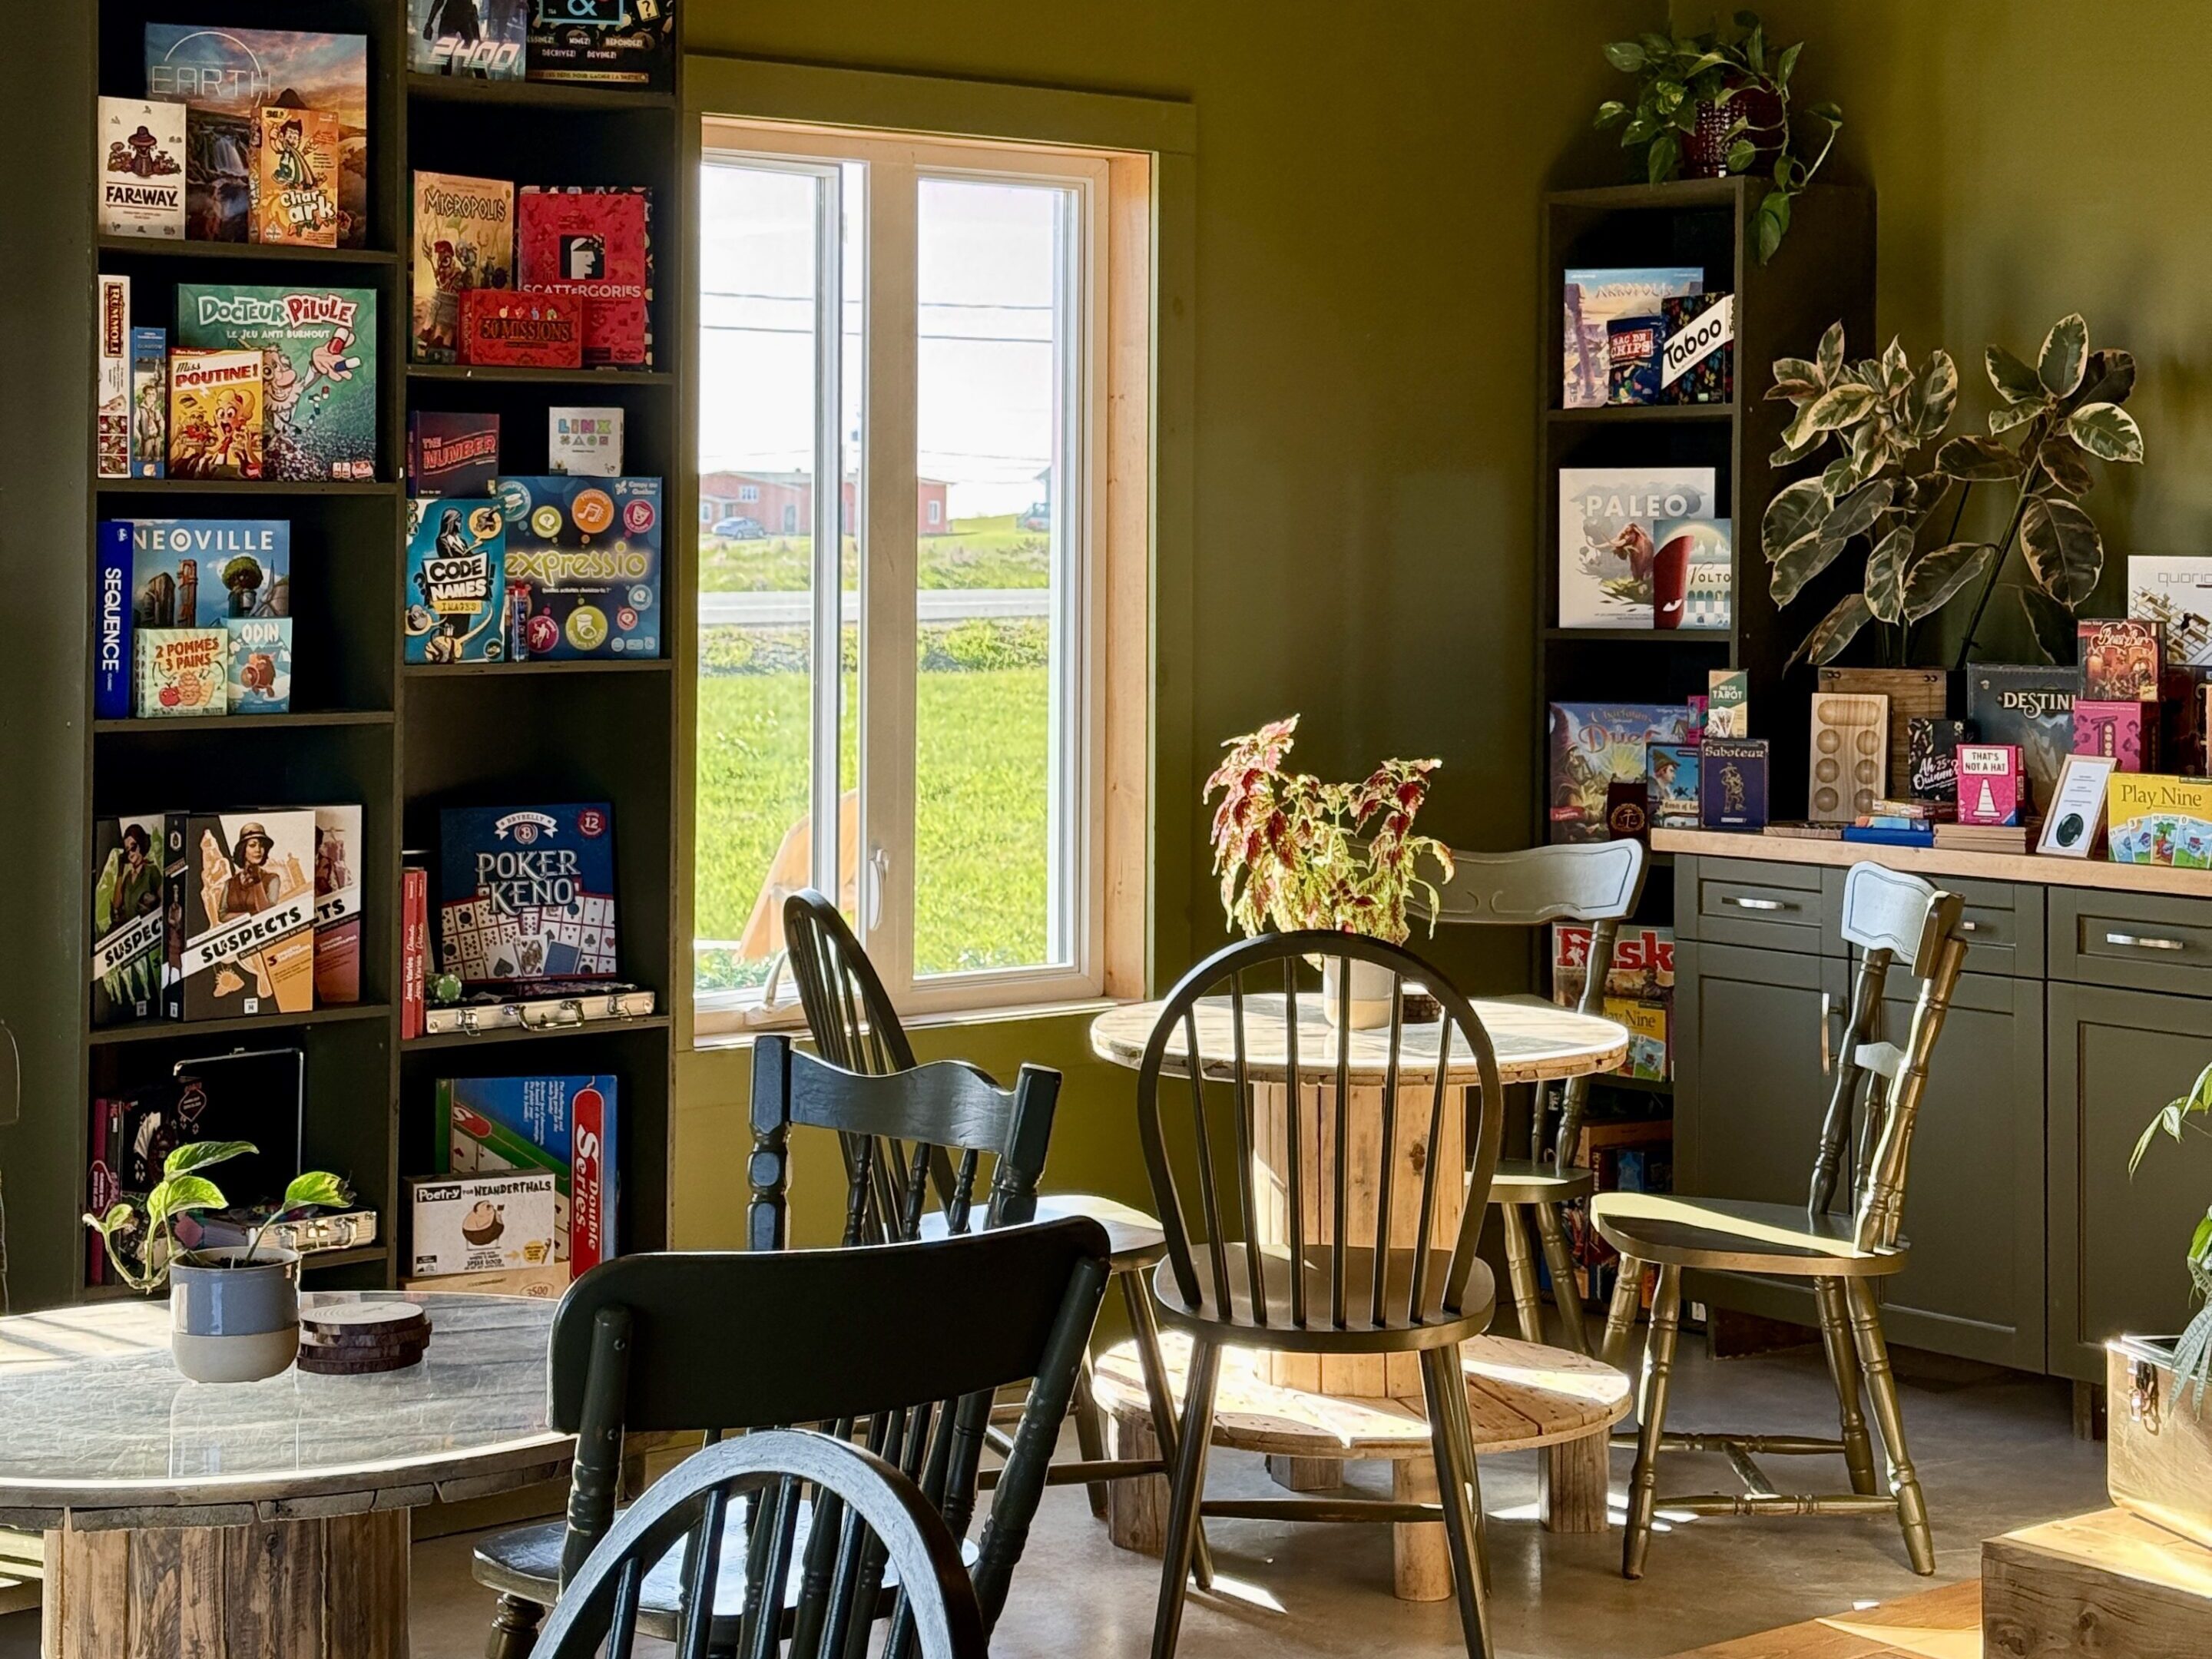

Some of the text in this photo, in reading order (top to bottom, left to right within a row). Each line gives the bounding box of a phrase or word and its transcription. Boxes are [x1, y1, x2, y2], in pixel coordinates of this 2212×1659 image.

[427, 36, 521, 70] 2400
[152, 66, 271, 98] EARTH
[106, 187, 178, 207] FARAWAY
[423, 189, 507, 223] MICROPOLIS
[200, 297, 287, 324] DOCTEUR
[241, 330, 258, 339] JEU
[261, 330, 283, 339] ANTI
[286, 330, 330, 339] BURNOUT
[502, 320, 570, 342] MISSIONS
[1664, 319, 1722, 370] Taboo
[422, 437, 442, 449] THE
[423, 435, 496, 469] NUMBER
[1587, 494, 1687, 517] PALEO
[134, 528, 273, 552] NEOVILLE
[429, 558, 484, 582] CODE
[505, 541, 647, 587] expressio
[430, 580, 488, 601] NAMES
[441, 602, 477, 612] IMAGES
[102, 568, 122, 671] SEQUENCE
[241, 623, 280, 644] ODIN
[156, 637, 220, 658] 2 POMMES
[166, 653, 211, 671] 3 PAINS
[1713, 690, 1743, 699] TAROT
[2003, 692, 2075, 719] DESTINI
[1705, 746, 1764, 759] Saboteur
[1972, 752, 1999, 761] THAT'S
[1965, 763, 2005, 772] NOT A HAT
[2121, 784, 2157, 809] Play
[2161, 786, 2202, 807] Nine
[584, 816, 599, 829] 12
[475, 849, 581, 885] POKER
[488, 878, 575, 916] KENO
[104, 916, 163, 968] SUSPEC
[200, 906, 301, 963] SUSPECTS
[1556, 927, 1674, 972] Rsk
[1625, 1008, 1657, 1028] Nine
[419, 1189, 460, 1202] Poetry
[474, 1181, 551, 1197] NEANDERTHALS
[588, 1178, 599, 1251] Double
